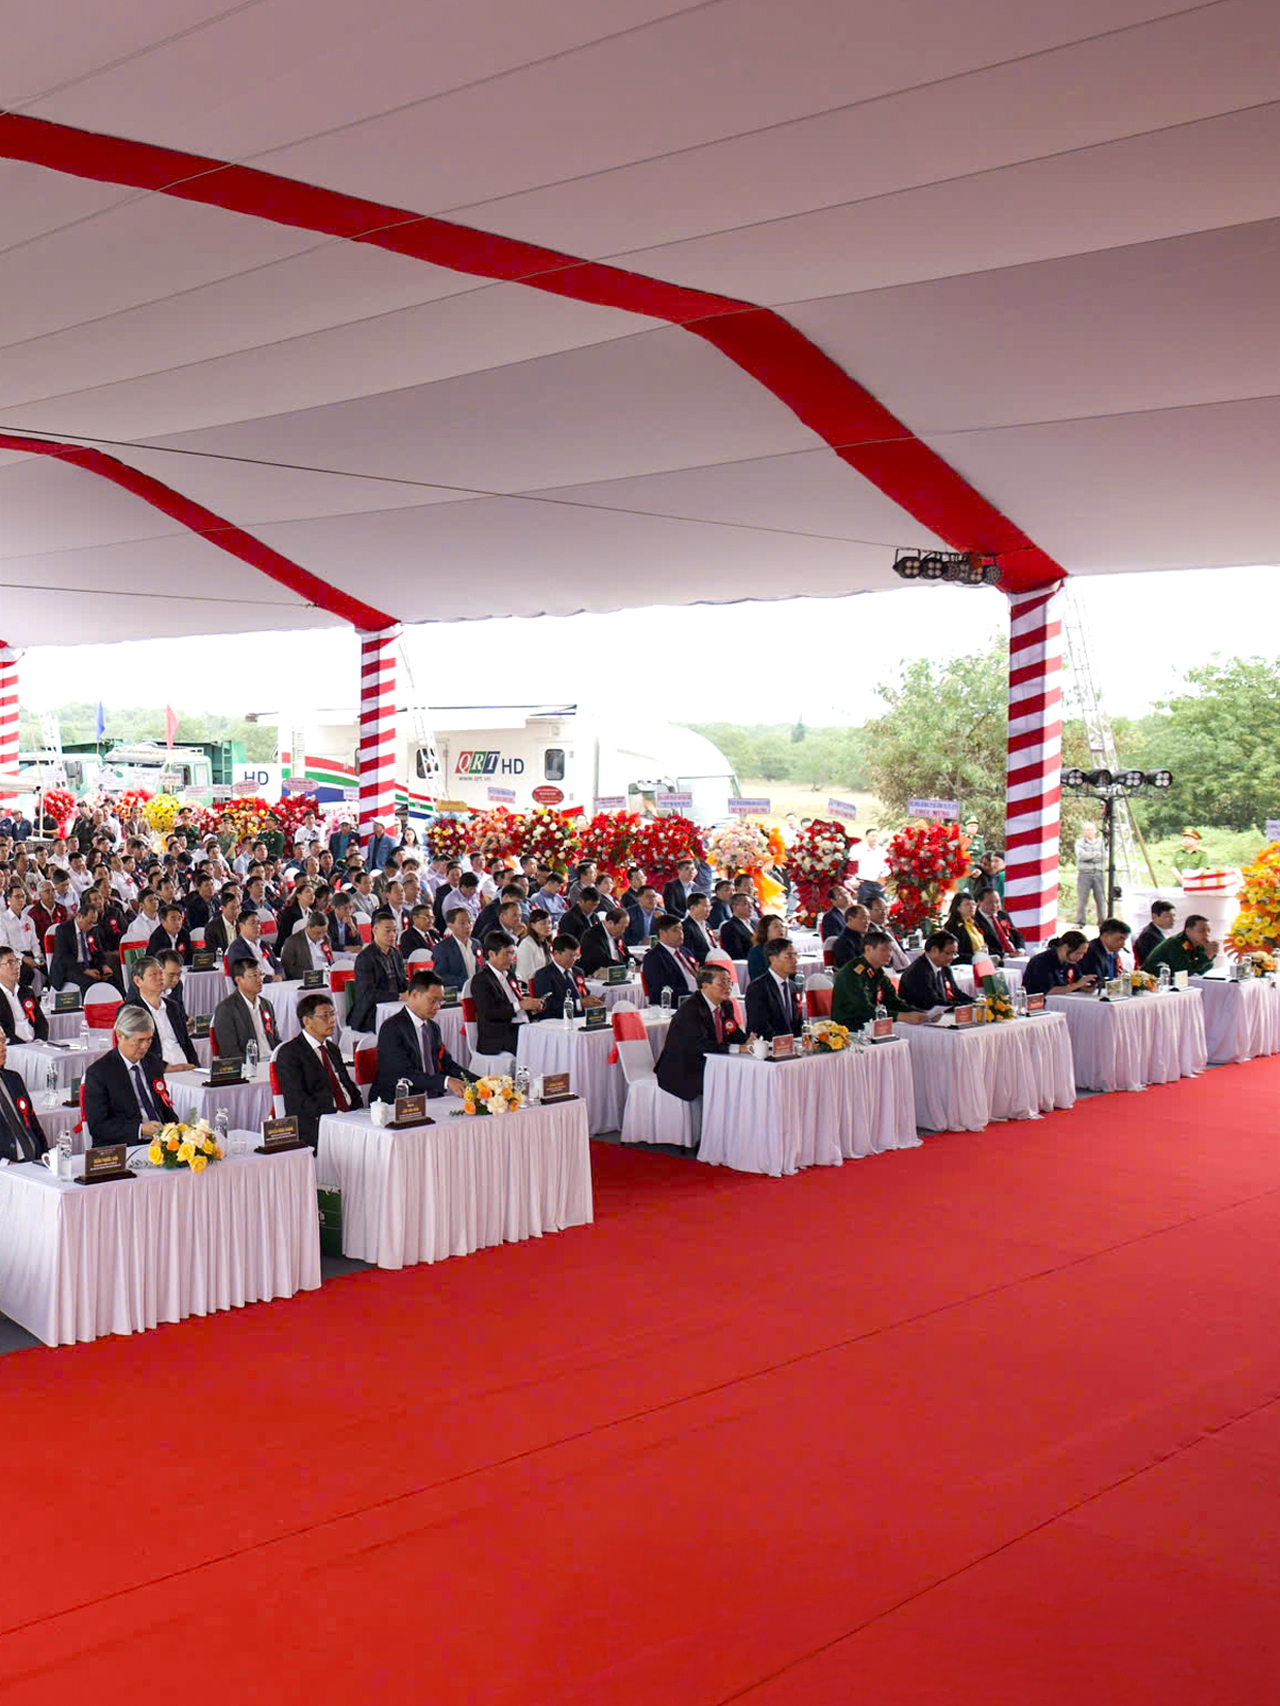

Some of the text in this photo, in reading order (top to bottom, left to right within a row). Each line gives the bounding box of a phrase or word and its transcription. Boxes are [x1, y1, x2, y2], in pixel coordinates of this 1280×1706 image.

[458, 752, 525, 774] QRT HD
[244, 771, 269, 786] HD
